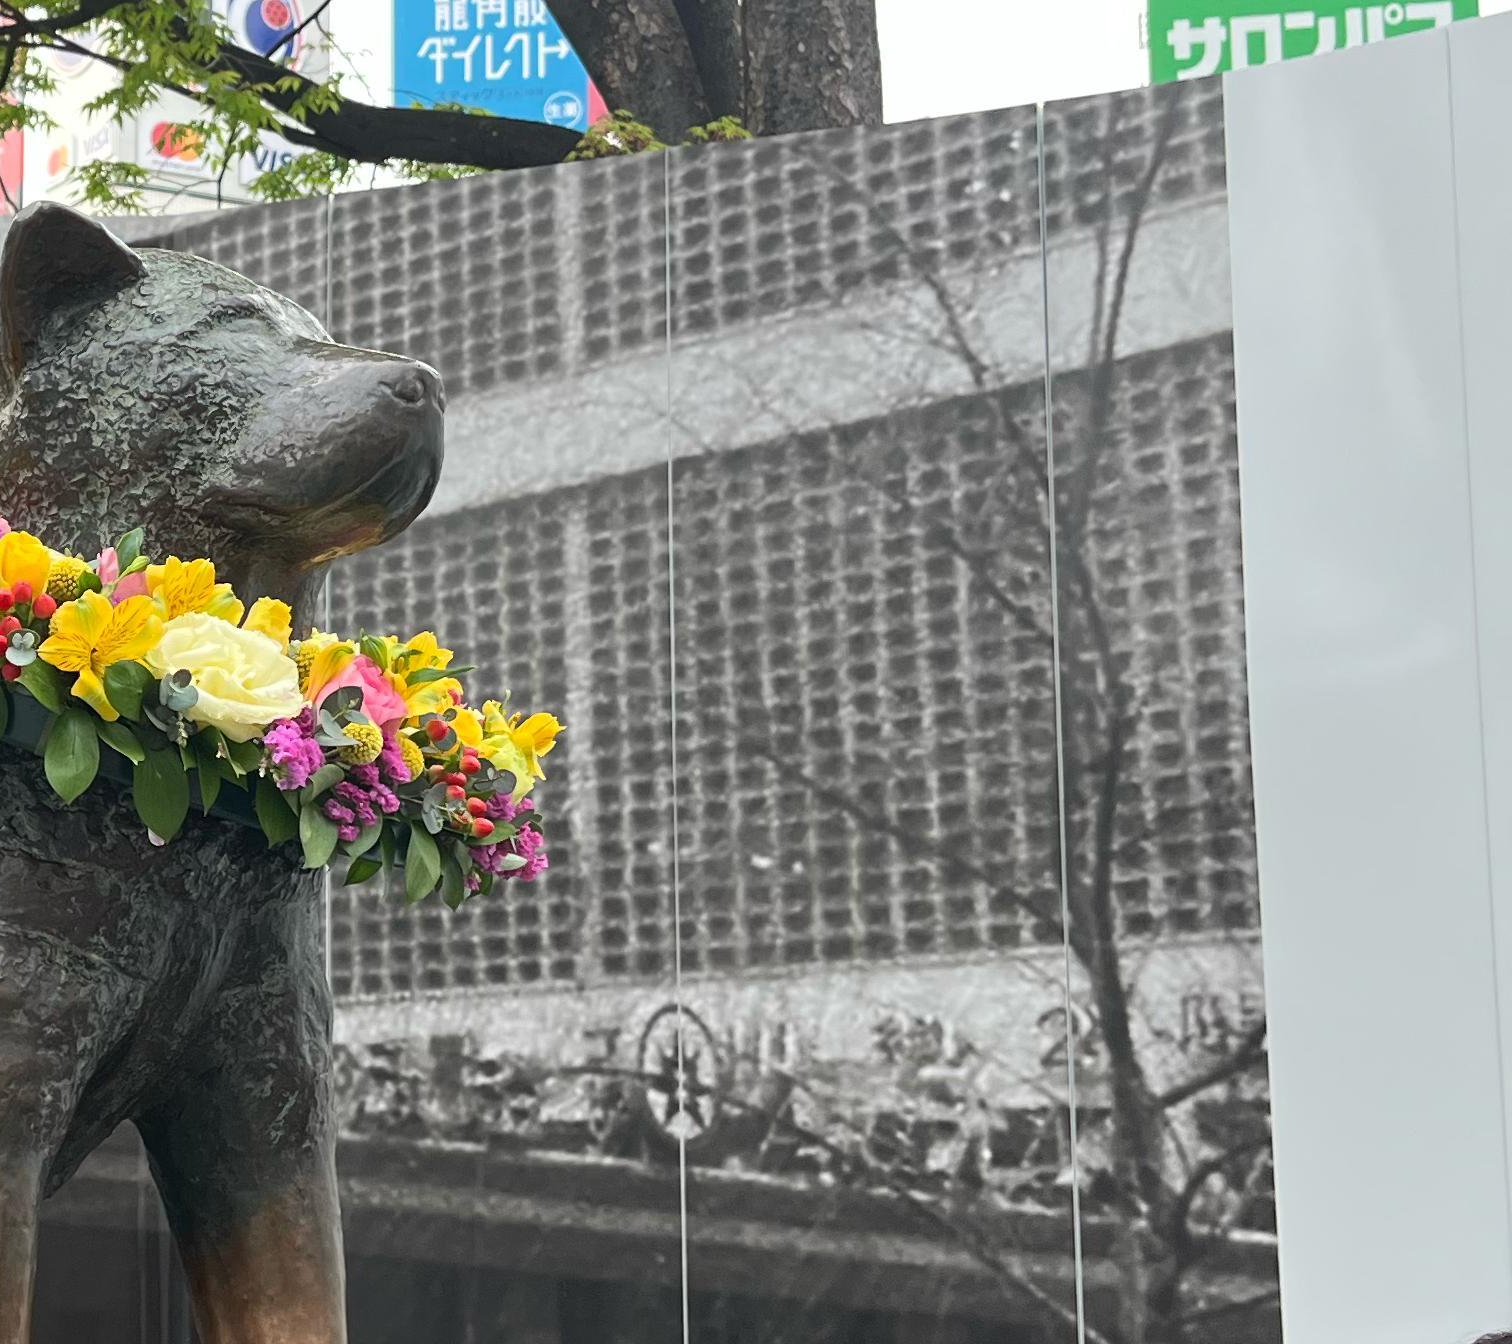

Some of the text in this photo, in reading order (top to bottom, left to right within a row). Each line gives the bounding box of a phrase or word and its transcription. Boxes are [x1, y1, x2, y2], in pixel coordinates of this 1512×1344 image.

[416, 32, 571, 86] ダイレクト
[253, 148, 294, 172] VIS
